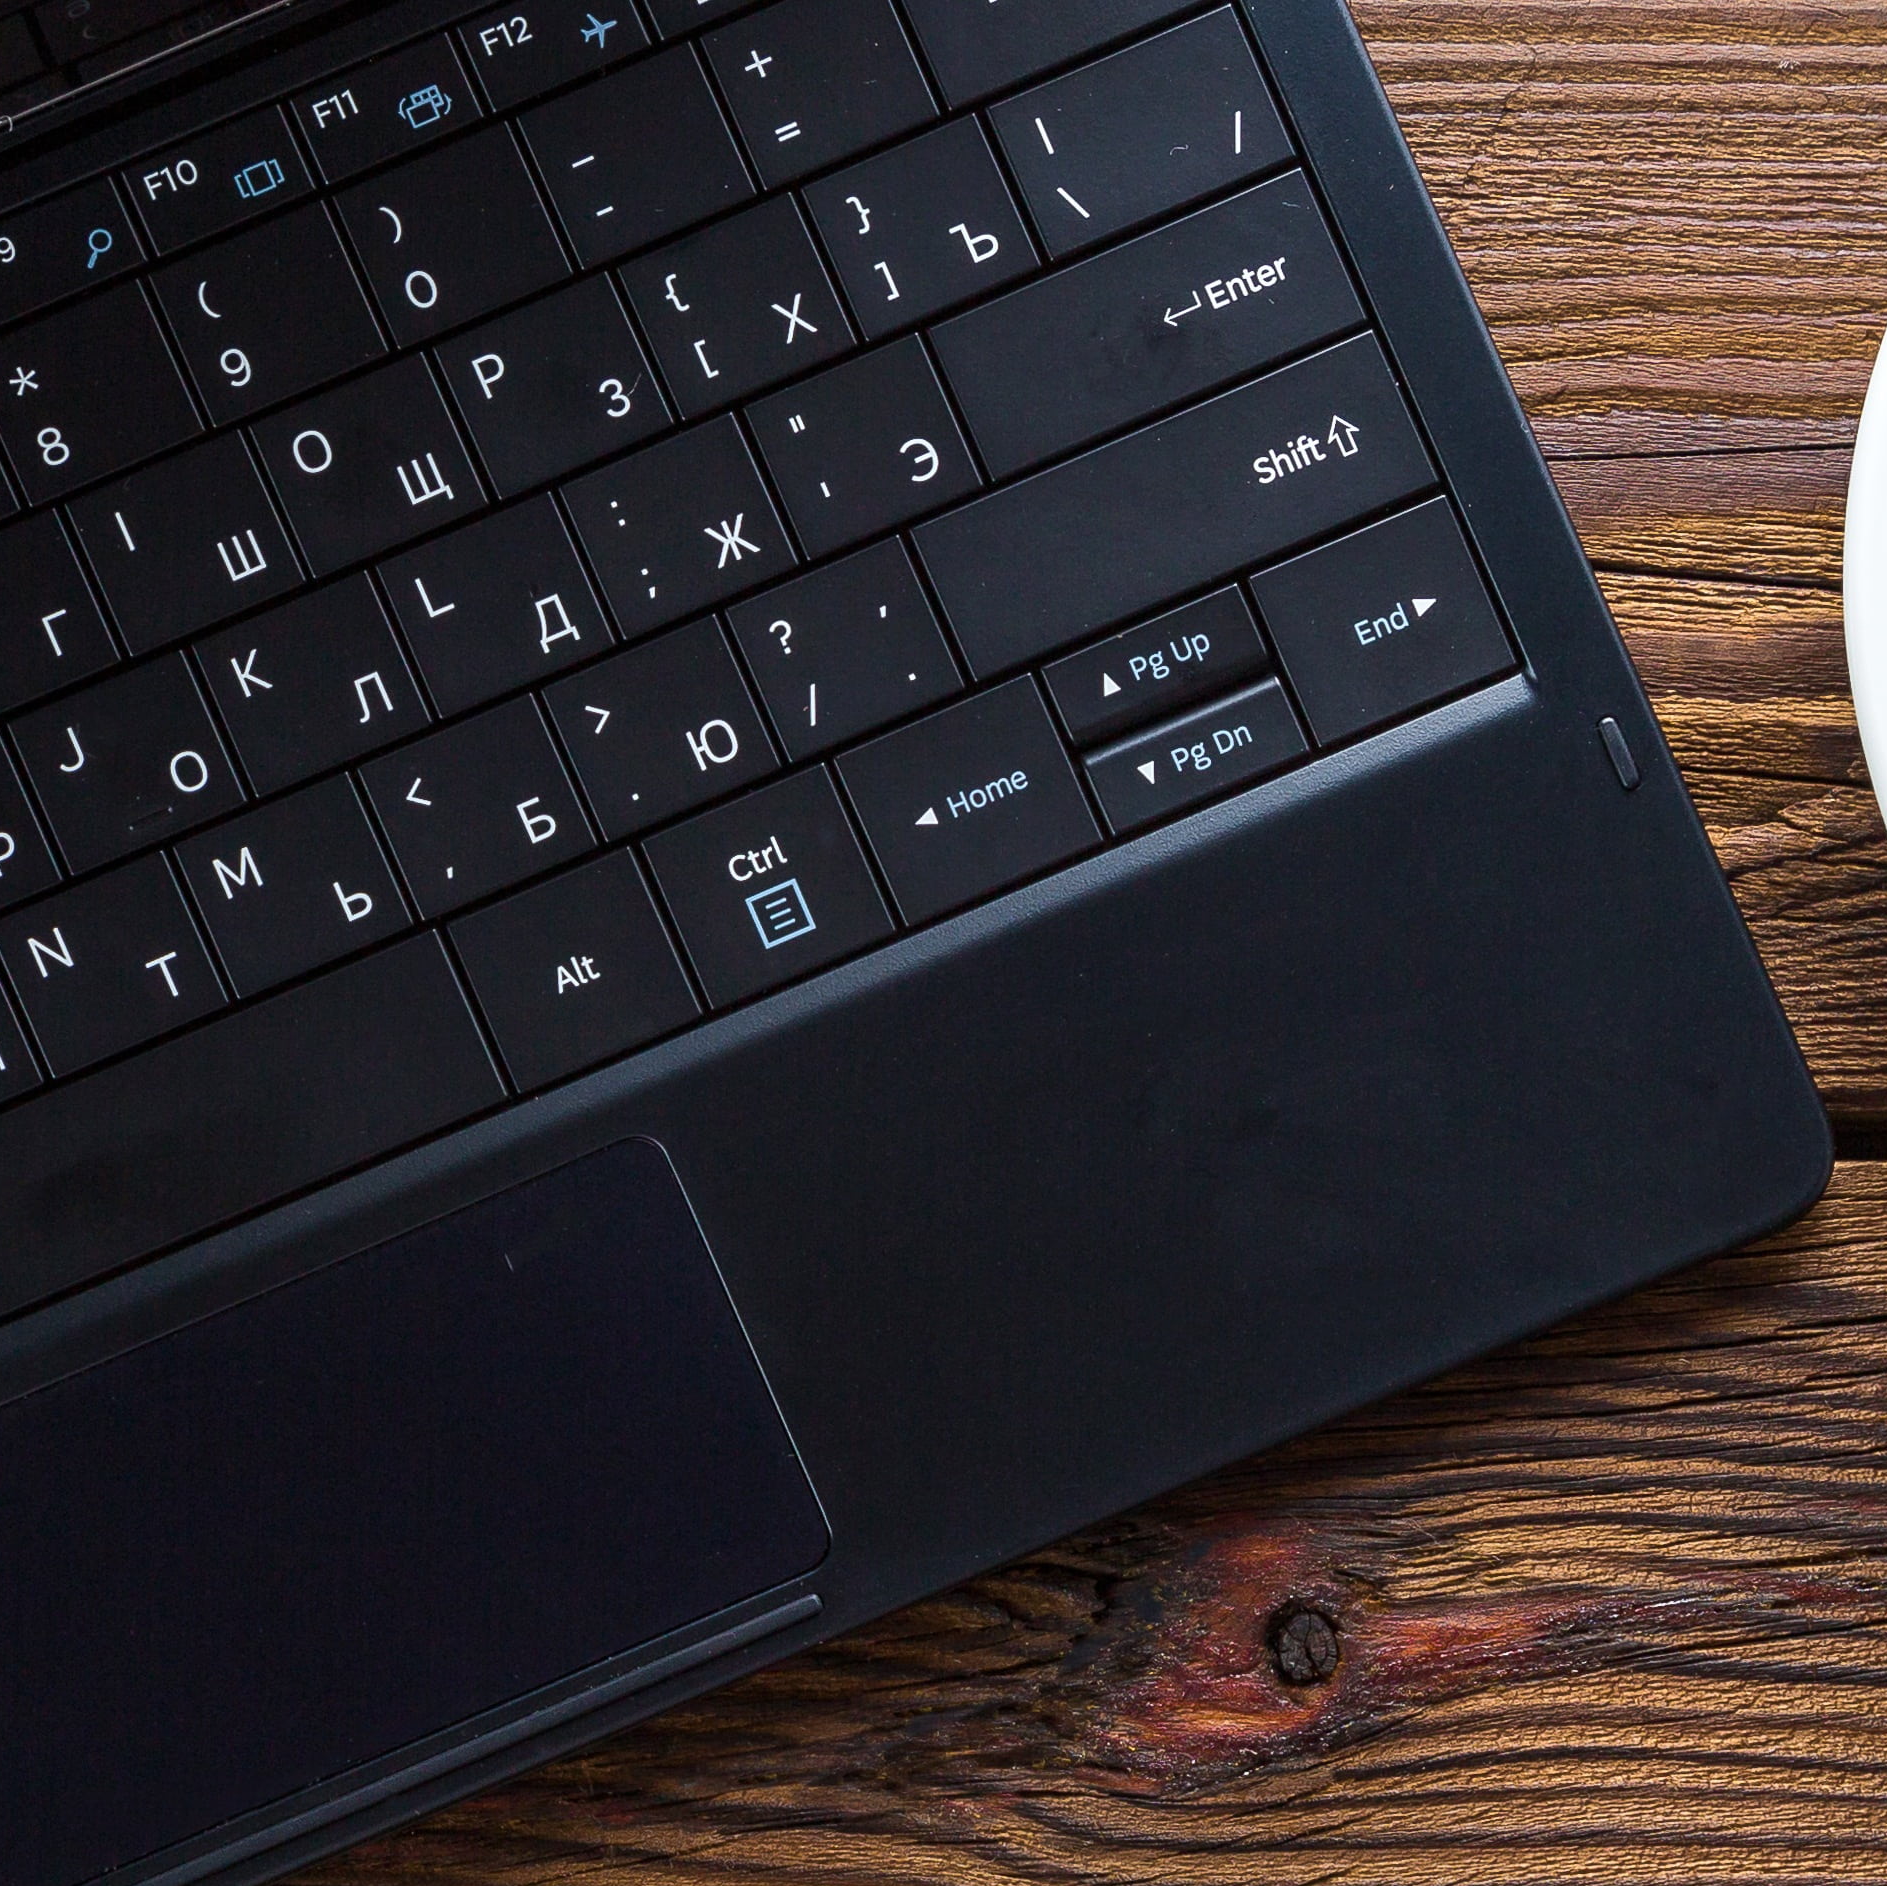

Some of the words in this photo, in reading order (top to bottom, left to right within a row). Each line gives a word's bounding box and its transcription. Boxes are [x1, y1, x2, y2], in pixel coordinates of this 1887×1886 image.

[479, 16, 533, 56] F12
[744, 49, 773, 79] +
[312, 90, 359, 128] F11
[774, 120, 802, 143] =
[143, 161, 199, 201] F10
[378, 205, 403, 245] )
[845, 195, 871, 235] }
[197, 280, 222, 319] (
[664, 273, 691, 313] {
[873, 260, 901, 302] ]
[1203, 256, 1286, 310] Enter
[219, 347, 252, 388] 9
[470, 352, 505, 400] P
[692, 338, 720, 379] [
[36, 426, 71, 467] 8
[1252, 434, 1328, 484] Shift
[414, 577, 456, 619] L
[768, 619, 793, 655] ?
[1353, 601, 1410, 646] End
[230, 648, 274, 699] K
[1128, 650, 1171, 682] Pg
[1169, 633, 1211, 663] Up
[584, 704, 611, 735] >
[59, 726, 86, 773] J
[1170, 741, 1212, 773] Pg
[1211, 725, 1253, 755] Dn
[405, 776, 433, 807] <
[945, 770, 1029, 819] Home
[211, 846, 264, 900] M
[727, 835, 789, 882] Ctrl
[26, 926, 75, 979] N
[556, 955, 602, 995] Alt
